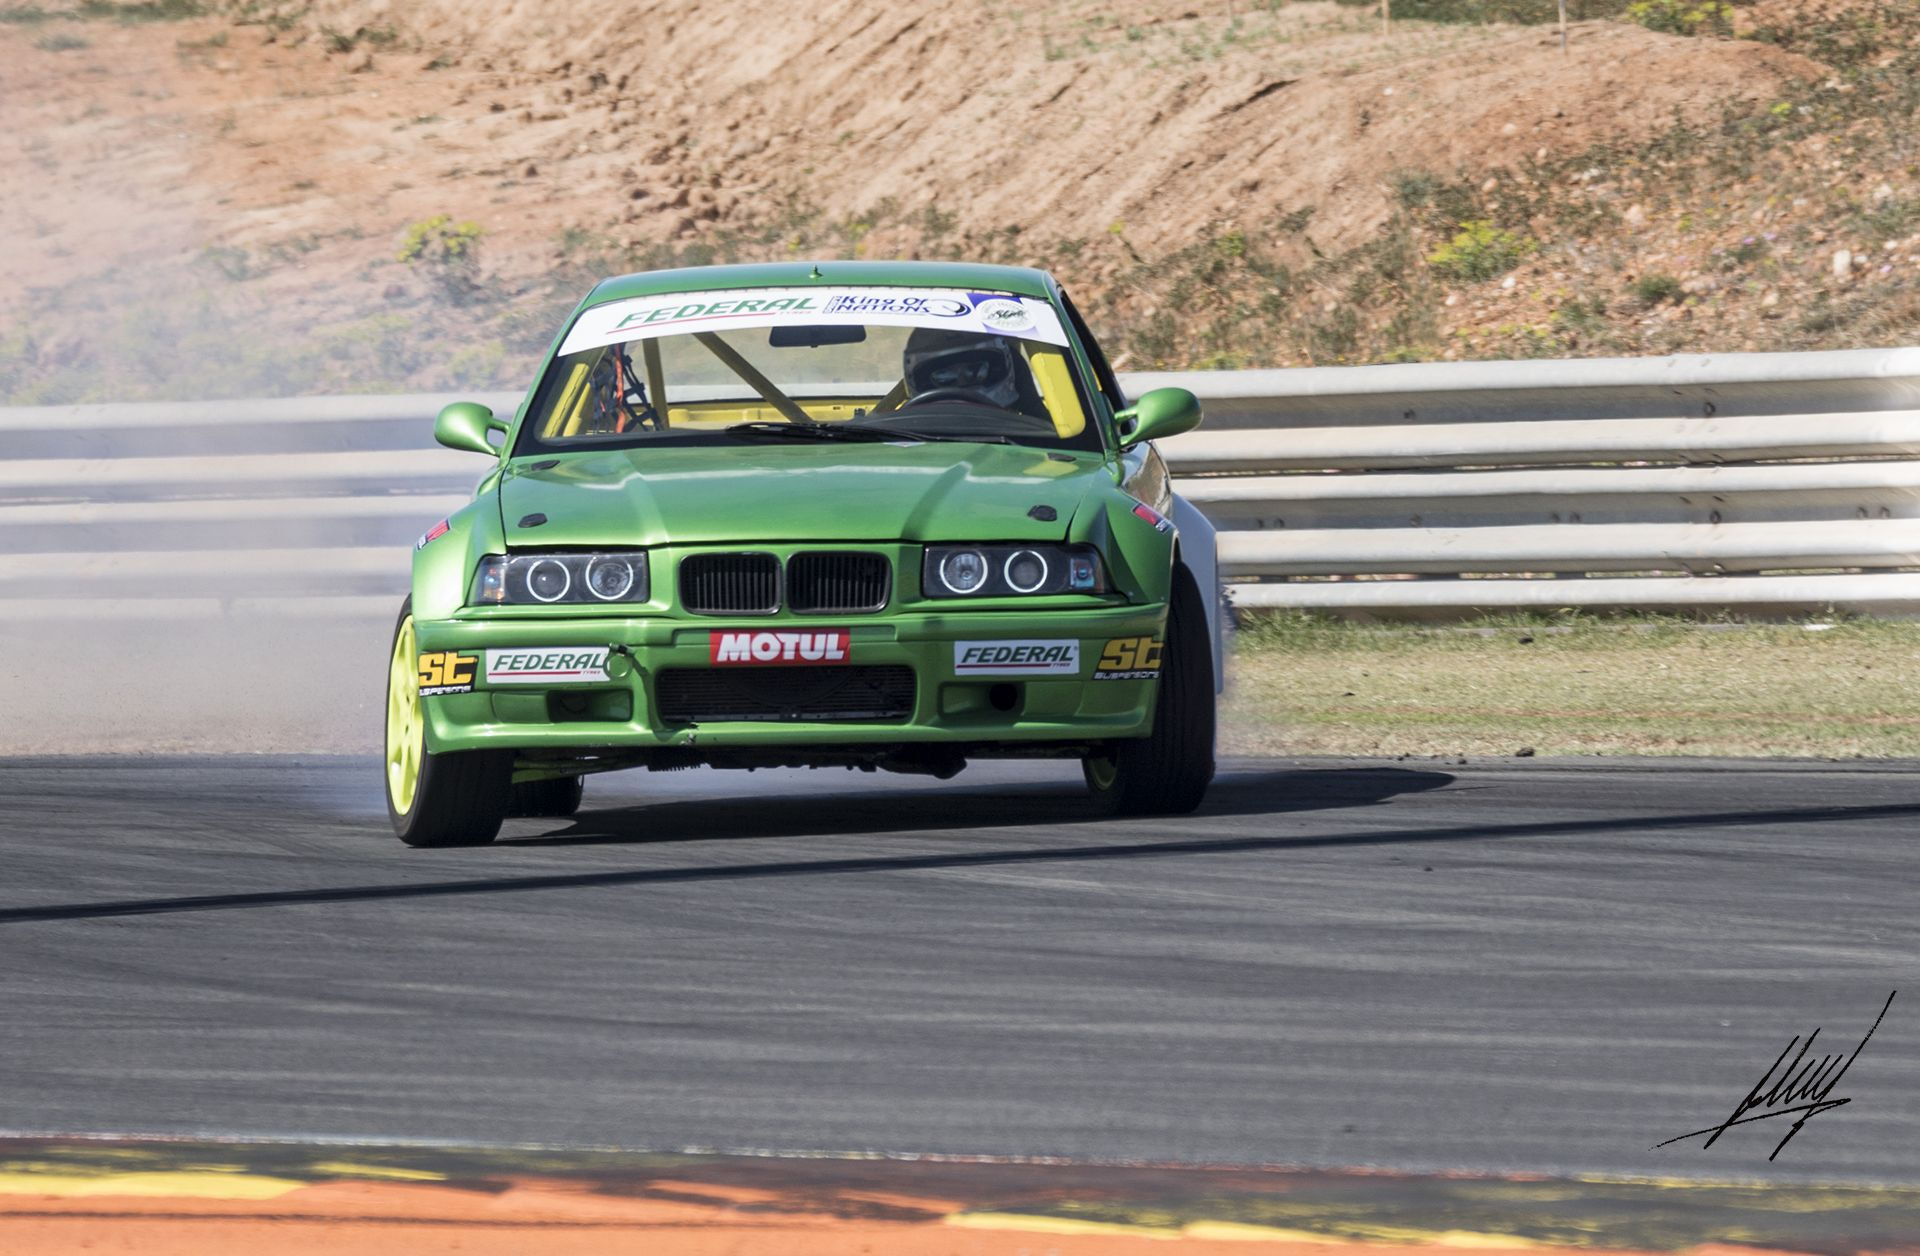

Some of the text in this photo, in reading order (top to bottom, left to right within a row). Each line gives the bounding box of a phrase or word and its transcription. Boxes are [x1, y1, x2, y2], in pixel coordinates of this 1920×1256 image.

[840, 295, 896, 305] King
[615, 297, 819, 329] FEDERAL
[716, 632, 845, 662] MOTUL
[962, 645, 1074, 663] FEDERAL
[492, 653, 605, 671] FEDERAL
